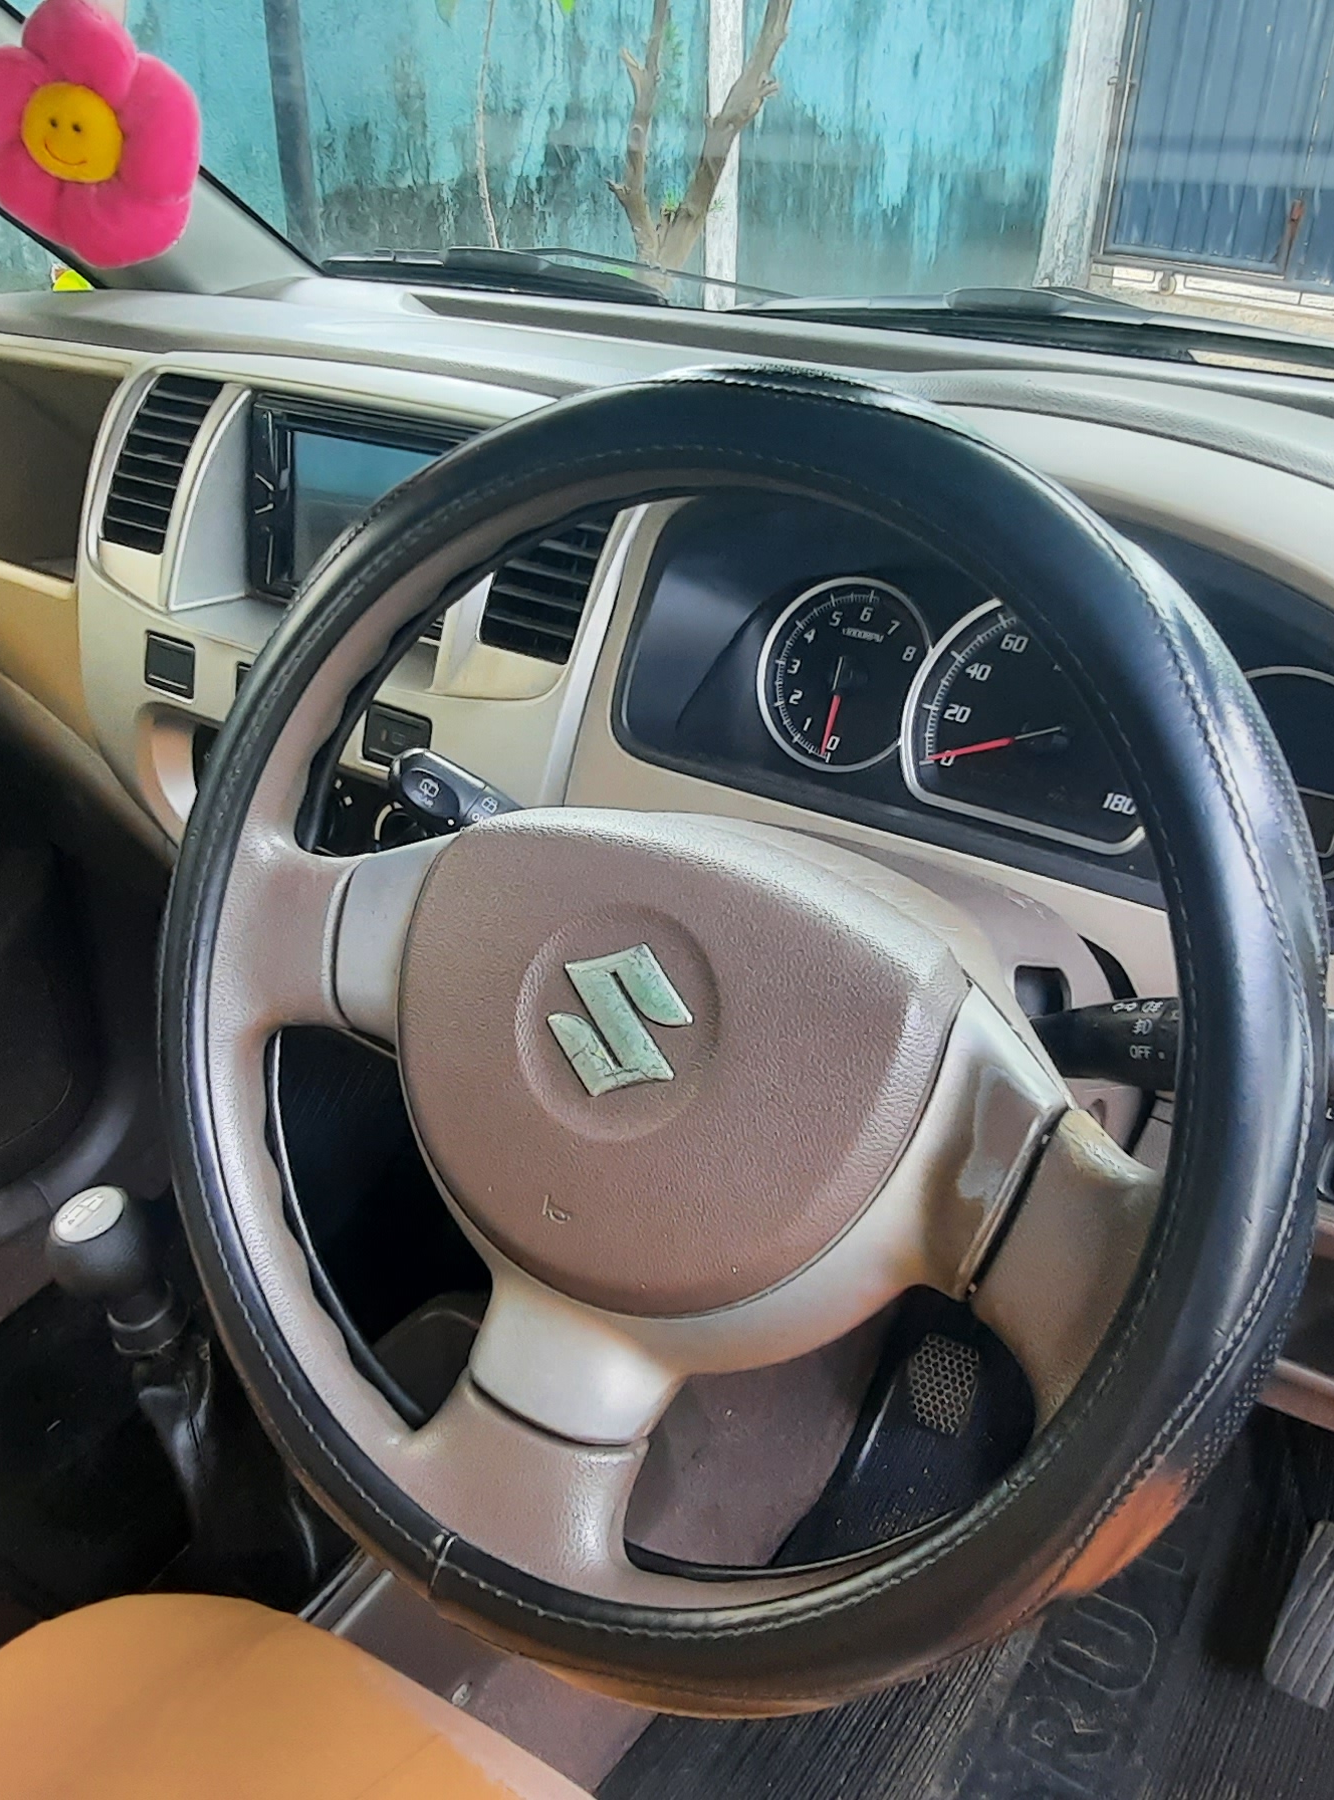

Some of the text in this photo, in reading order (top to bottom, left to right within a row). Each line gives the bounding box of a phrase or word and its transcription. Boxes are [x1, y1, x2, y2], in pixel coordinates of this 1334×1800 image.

[829, 611, 843, 627] 5
[860, 607, 873, 622] 6
[887, 620, 901, 635] 7
[804, 629, 816, 644] 4
[1001, 633, 1029, 653] 60
[902, 646, 917, 662] 8
[787, 659, 801, 674] 3
[965, 662, 992, 681] 40
[789, 689, 803, 704] 2
[943, 703, 971, 723] 20
[803, 717, 812, 732] 1
[827, 736, 840, 751] 0
[1129, 1044, 1152, 1060] OFF
[1326, 1107, 1333, 1120] L
